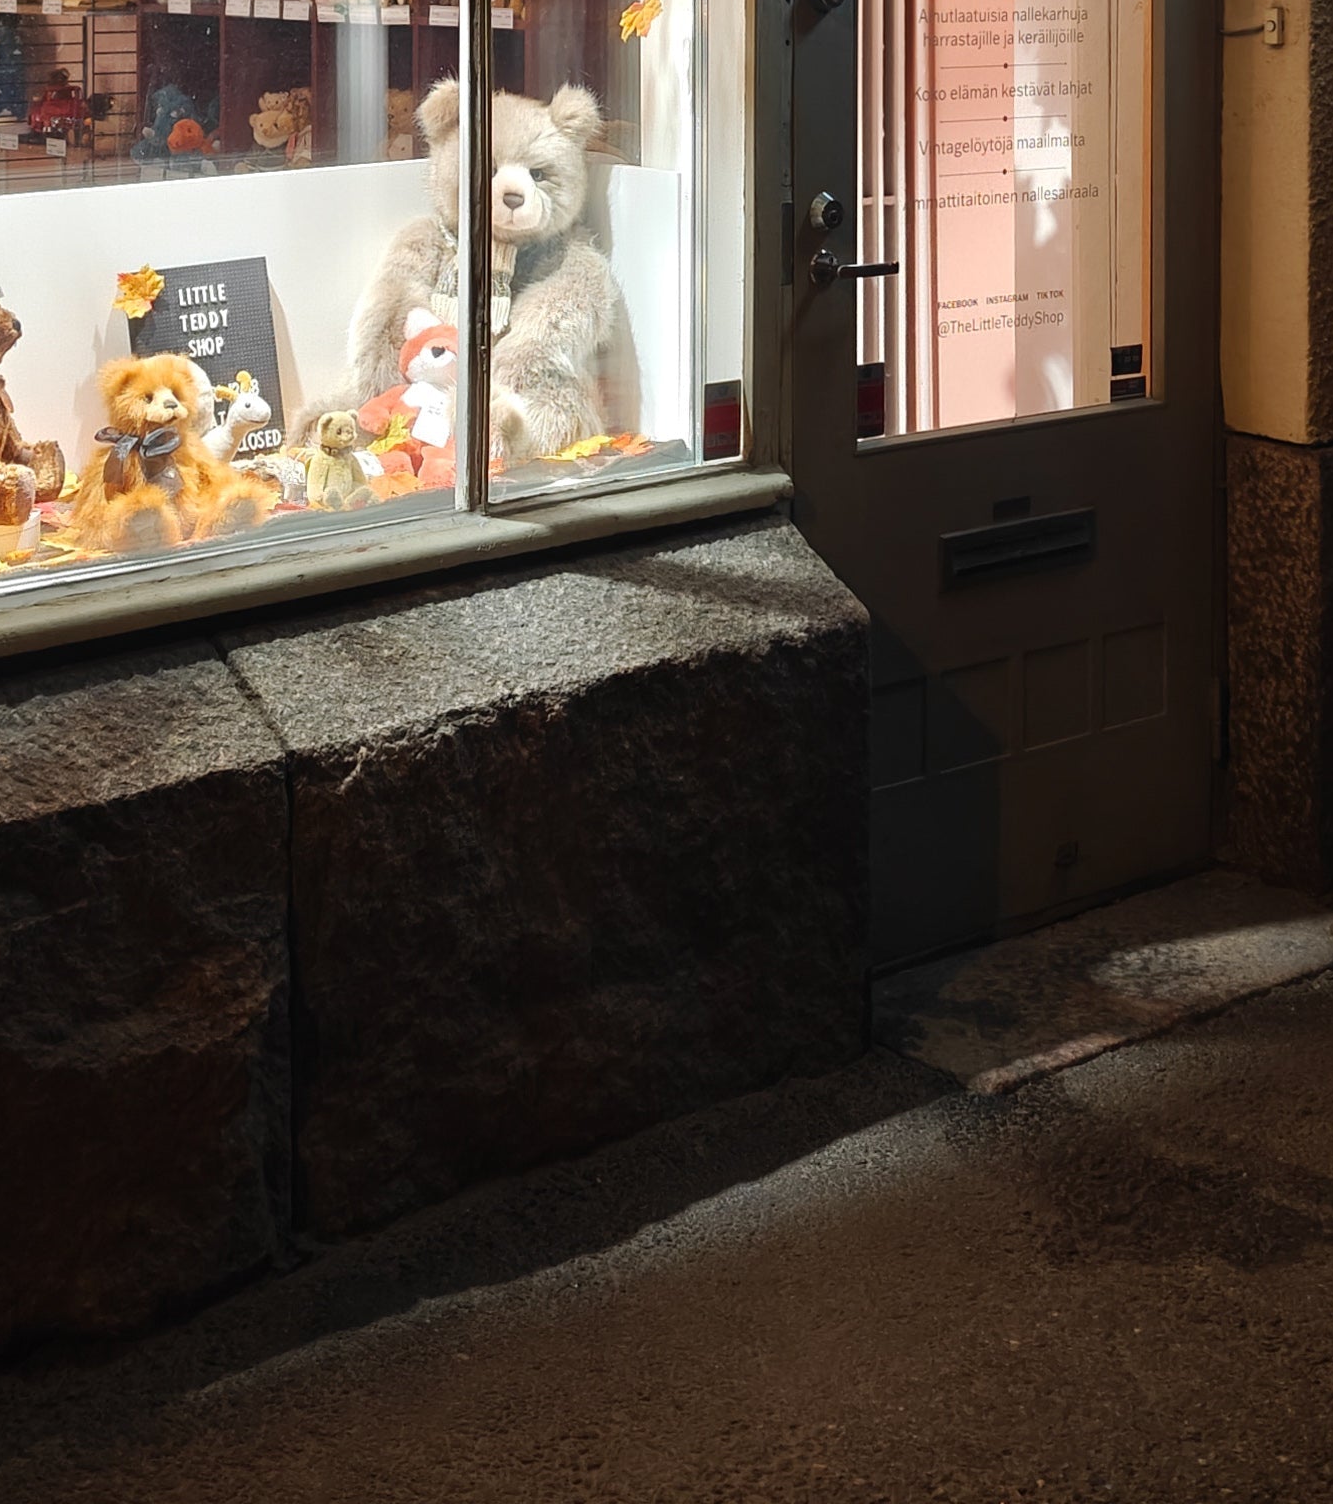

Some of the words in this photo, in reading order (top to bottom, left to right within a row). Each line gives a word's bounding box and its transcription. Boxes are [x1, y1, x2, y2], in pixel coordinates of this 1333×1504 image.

[1012, 6, 1089, 24] nallekarhuja
[923, 31, 1000, 50] harrastajille
[1003, 29, 1014, 49] ja
[1018, 27, 1084, 47] keräilijöille
[915, 86, 947, 102] Koko
[950, 84, 998, 101] elämän
[1001, 81, 1055, 98] kestävät
[1058, 80, 1092, 99] lahjat
[1017, 133, 1085, 149] maailmalta
[903, 191, 1018, 211] mmattitaitoinen
[1021, 183, 1099, 203] nallesairaala
[178, 283, 227, 307] LITTLE
[937, 298, 979, 310] FACEBOOK
[986, 293, 1029, 305] INSTAGRAM
[179, 309, 228, 333] TEDDY
[937, 311, 1064, 338] @TheLittleTeddyShop
[188, 336, 224, 358] SHOP
